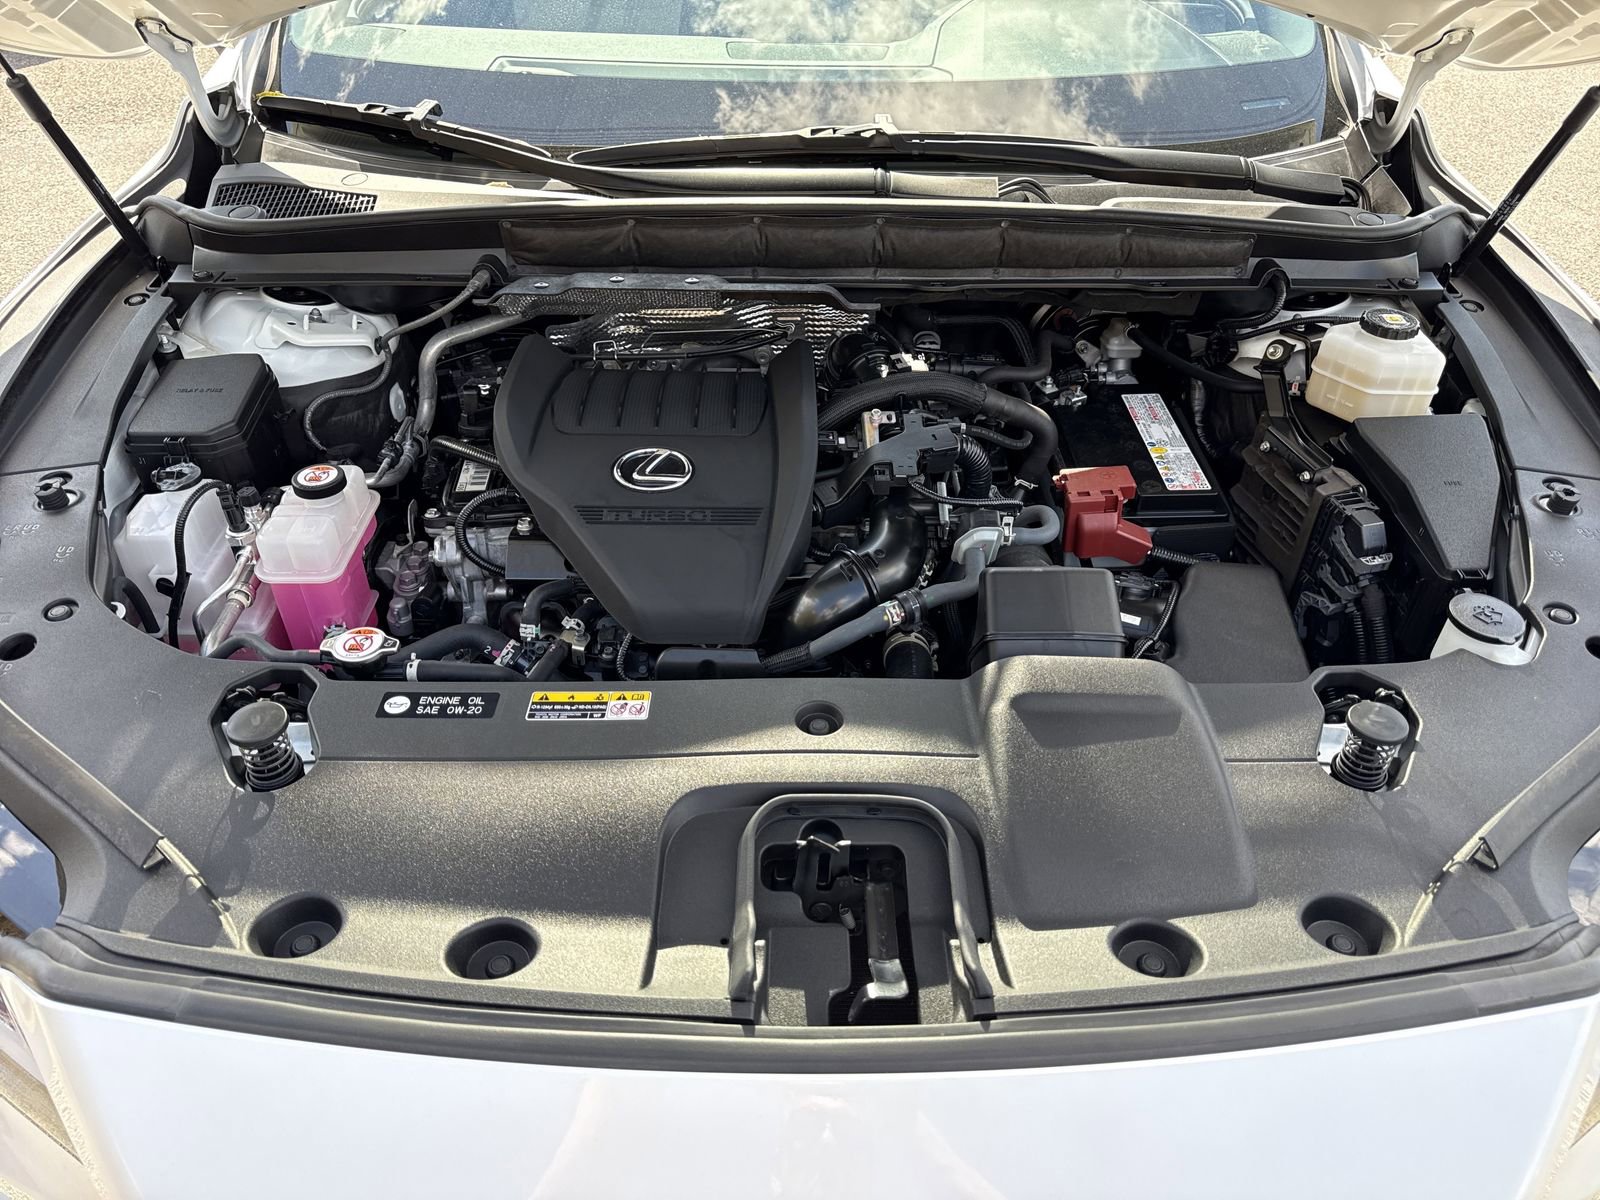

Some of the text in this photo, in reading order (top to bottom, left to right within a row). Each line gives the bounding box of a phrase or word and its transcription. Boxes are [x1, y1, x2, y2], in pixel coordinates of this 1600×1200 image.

[607, 510, 708, 521] TURBO
[419, 696, 485, 705] ENGINE OIL
[415, 706, 482, 714] SAE 0W-20
